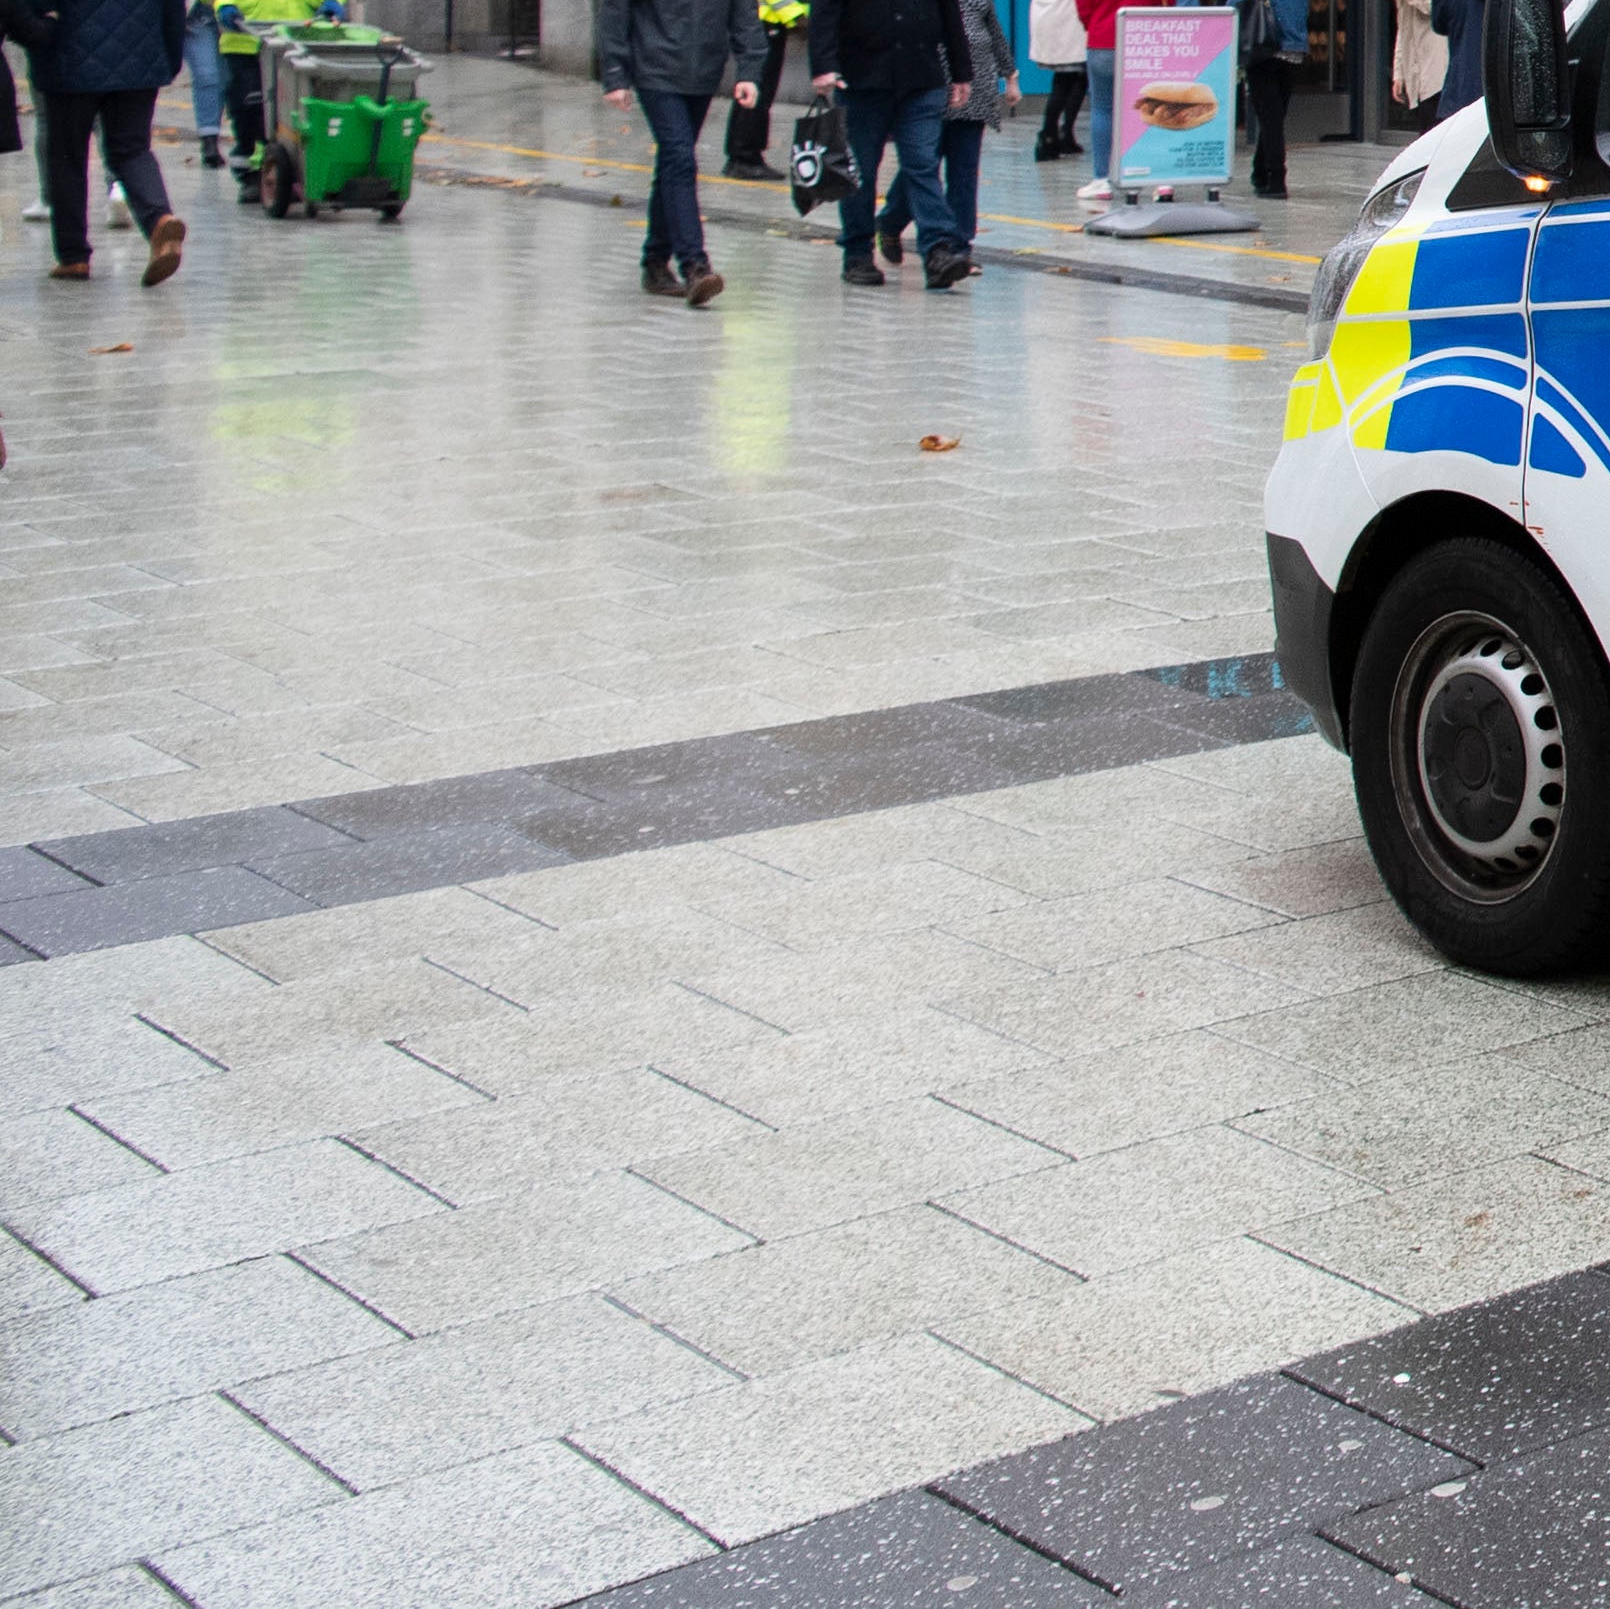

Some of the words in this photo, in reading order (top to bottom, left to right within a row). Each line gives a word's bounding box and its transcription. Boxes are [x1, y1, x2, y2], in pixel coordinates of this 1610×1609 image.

[1126, 20, 1201, 31] BREAKFAST
[1126, 32, 1159, 44] DEAL
[1161, 33, 1193, 44] THAT
[1173, 45, 1199, 57] YOU
